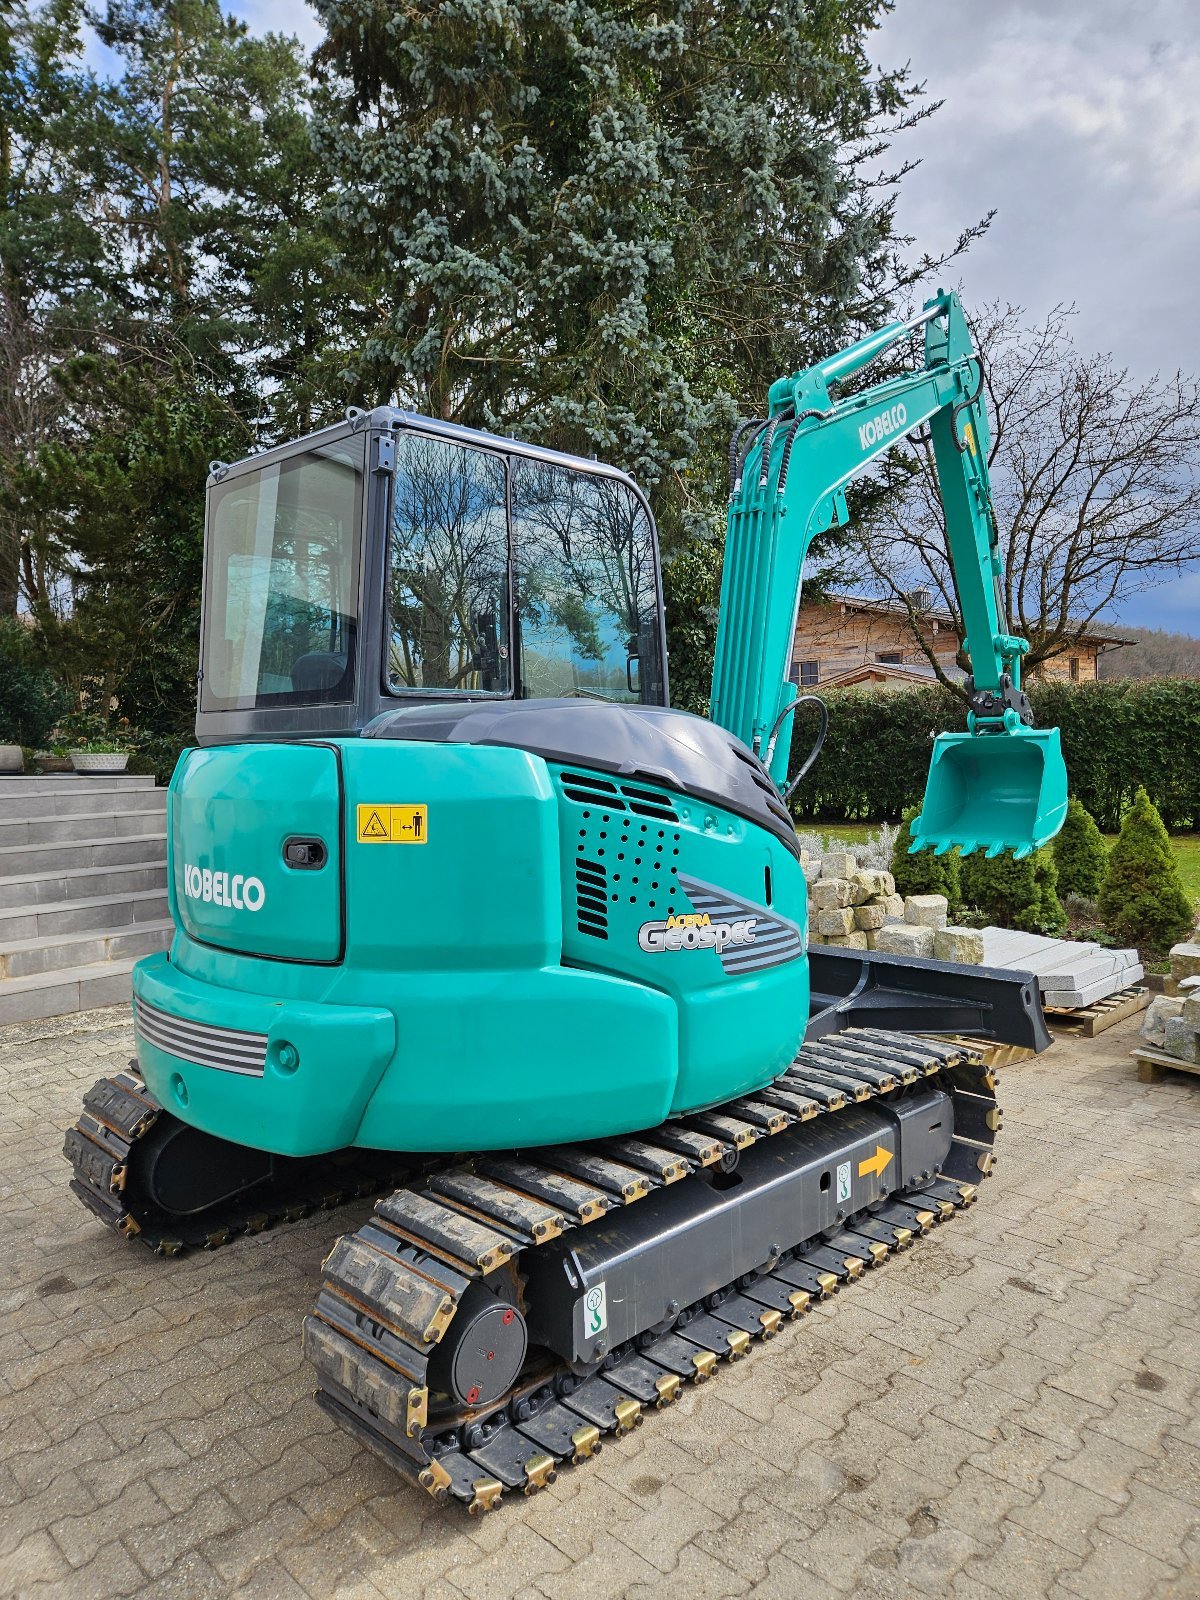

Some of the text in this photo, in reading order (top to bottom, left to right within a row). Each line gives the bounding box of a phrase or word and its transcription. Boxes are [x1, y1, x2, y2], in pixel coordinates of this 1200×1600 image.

[859, 403, 907, 450] KOBELCO
[184, 863, 265, 912] KOBELCO
[666, 913, 712, 928] ACERA
